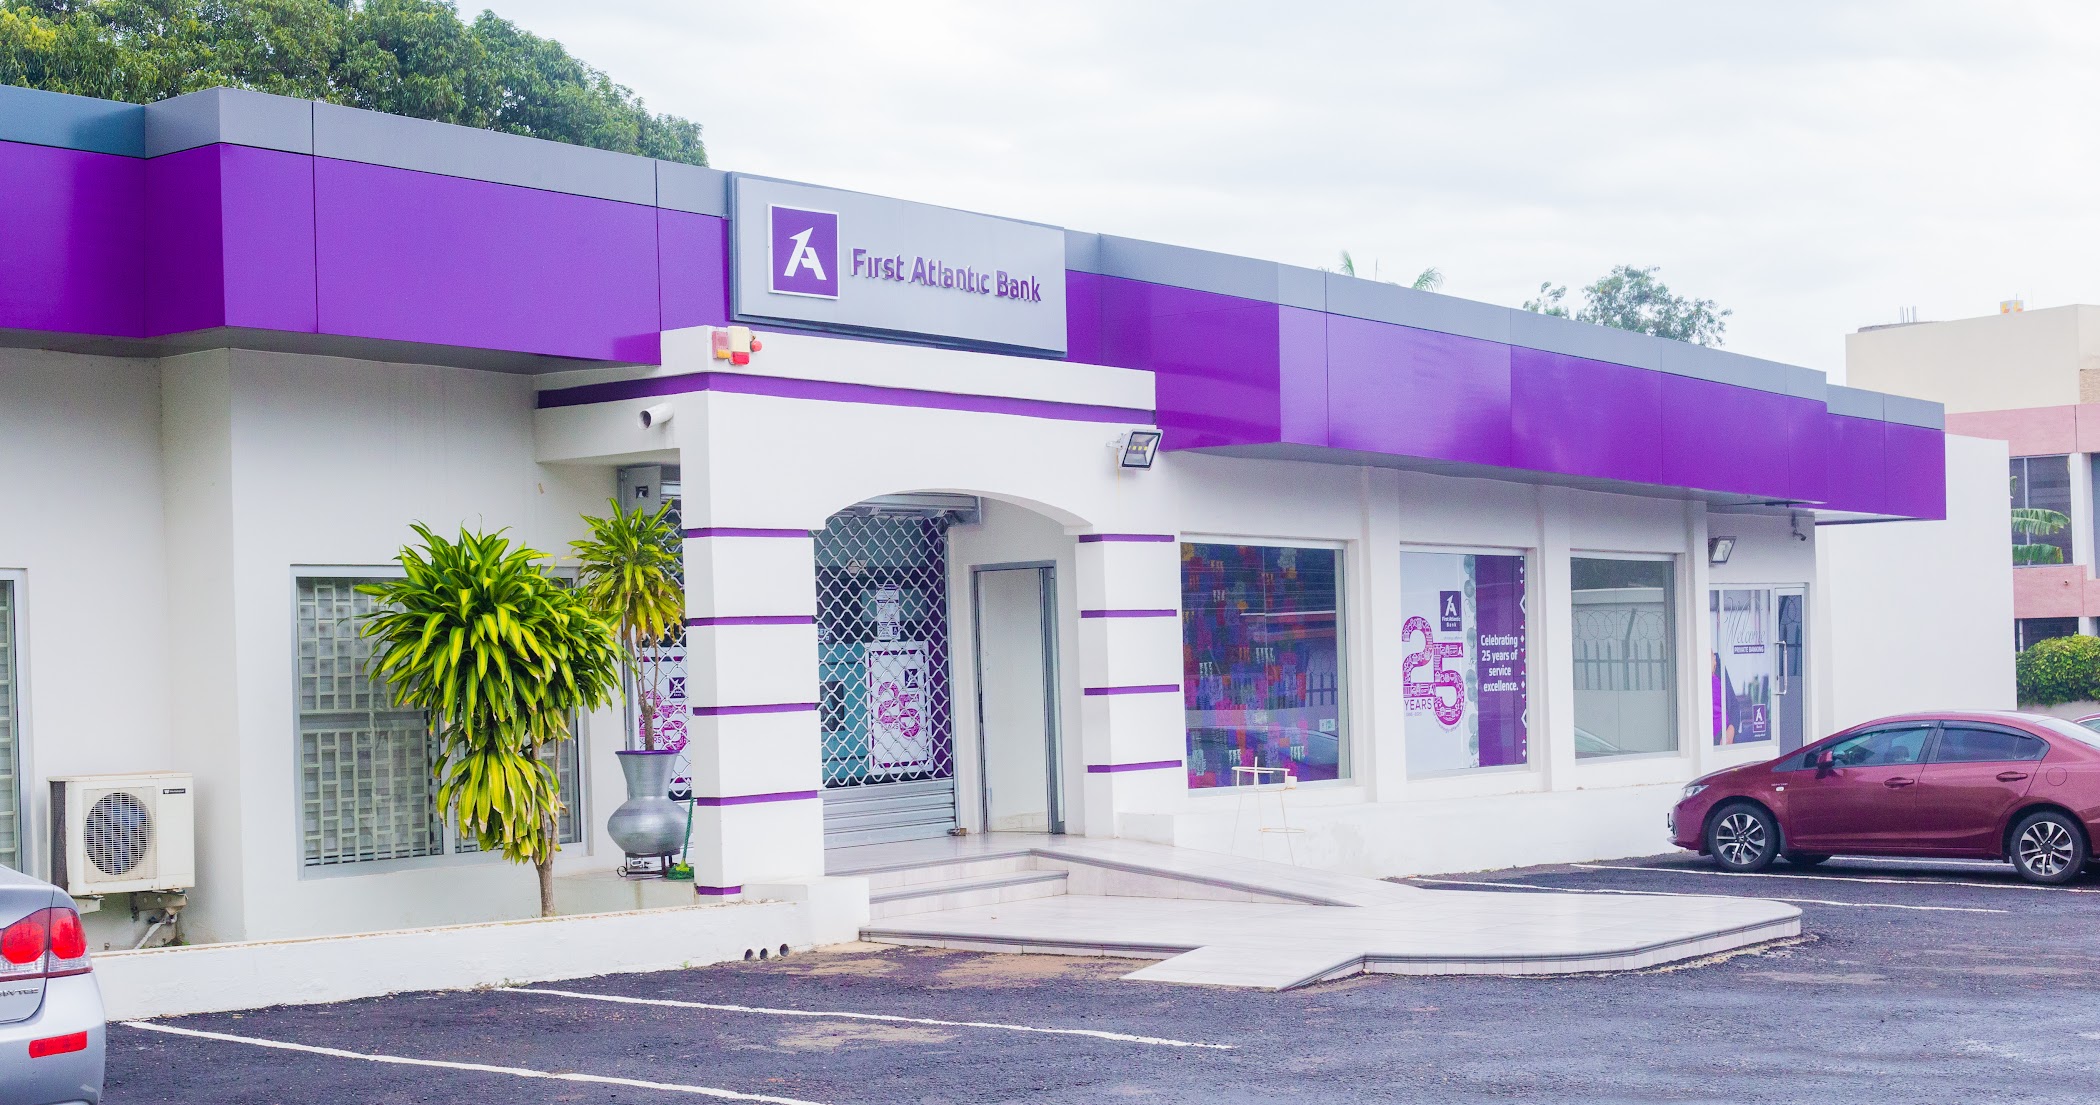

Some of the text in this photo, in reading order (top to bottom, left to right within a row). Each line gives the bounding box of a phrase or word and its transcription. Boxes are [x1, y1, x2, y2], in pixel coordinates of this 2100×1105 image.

[851, 248, 1041, 303] First Atlantic Bank
[1480, 633, 1518, 648] Celebrating
[1481, 649, 1518, 664] 25 years of
[1401, 616, 1465, 726] 25
[1488, 664, 1512, 677] service
[1483, 679, 1519, 692] excellence.
[1404, 698, 1432, 711] YEARS
